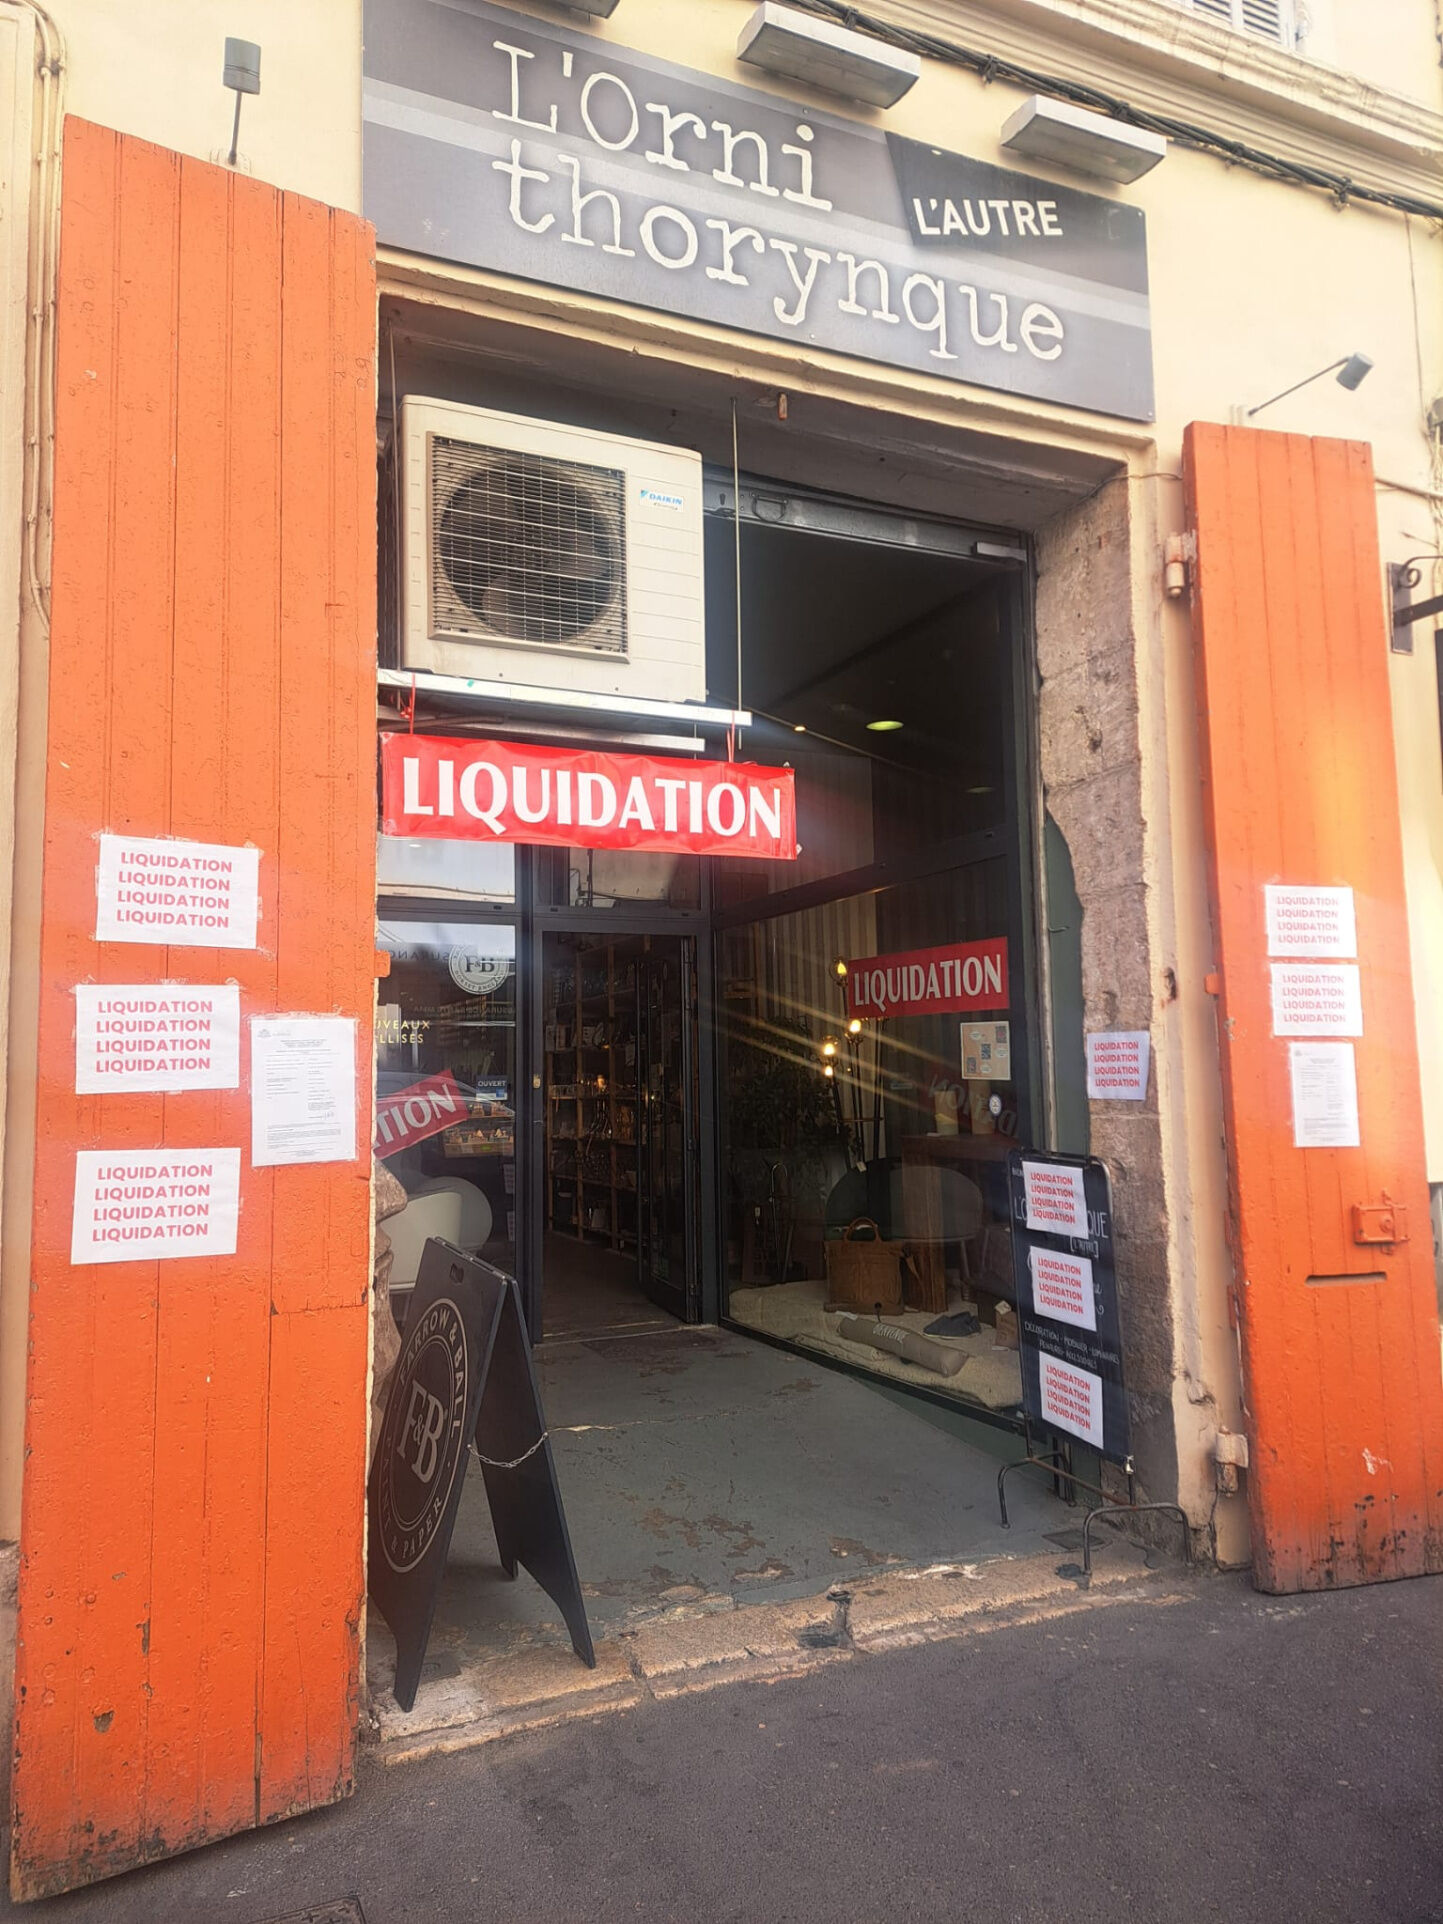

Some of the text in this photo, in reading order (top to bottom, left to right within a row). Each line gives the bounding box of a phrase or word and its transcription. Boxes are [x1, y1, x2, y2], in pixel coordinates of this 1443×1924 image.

[491, 40, 832, 211] L'Orni
[912, 198, 1064, 238] L'AUTRE
[491, 139, 1065, 362] thorynque
[649, 493, 683, 505] DAIKIN
[402, 756, 782, 839] LIQUIDATION
[121, 852, 232, 872] LIQUIDATION
[118, 872, 230, 891] LIQUIDATION
[118, 891, 229, 909] LIQUIDATION
[1277, 896, 1338, 906] LIQUIDATION
[117, 910, 229, 928] LIQUIDATION
[1277, 908, 1338, 919] LIQUIDATION
[1278, 921, 1338, 931] LIQUIDATION
[1278, 934, 1339, 944] LIQUIDATION
[853, 953, 1003, 1012] LIQUIDATION
[1283, 974, 1344, 985] LIQUIDATION
[1283, 986, 1344, 998] LIQUIDATION
[98, 1001, 212, 1015] LIQUIDATION
[1283, 1000, 1345, 1010] LIQUIDATION
[96, 1019, 210, 1033] LIQUIDATION
[1284, 1013, 1346, 1023] LIQUIDATION
[96, 1038, 210, 1055] LIQUIDATION
[1094, 1042, 1139, 1051] LIQUIDATION
[96, 1057, 210, 1073] LIQUIDATION
[1094, 1054, 1139, 1063] LIQUIDATION
[1094, 1066, 1139, 1075] LIQUIDATION
[1095, 1078, 1139, 1087] LIQUIDATION
[98, 1165, 212, 1181] LIQUIDATION
[1030, 1173, 1073, 1185] LIQUIDATION
[95, 1184, 210, 1201] LIQUIDATION
[1031, 1185, 1074, 1198] LIQUIDATION
[1031, 1197, 1074, 1210] LIQUIDATION
[94, 1204, 209, 1221] LIQUIDATION
[1033, 1209, 1075, 1224] LIQUIDATION
[92, 1224, 208, 1242] LIQUIDATION
[1038, 1259, 1080, 1275] LIQUIDATION
[1038, 1271, 1081, 1288] LIQUIDATION
[1039, 1284, 1082, 1301] LIQUIDATION
[1040, 1295, 1083, 1314] LIQUIDATION
[1047, 1366, 1090, 1391] LIQUIDATION
[450, 1345, 464, 1439] BALL
[1046, 1379, 1090, 1403] LIQUIDATION
[1047, 1390, 1090, 1416] LIQUIDATION
[1048, 1404, 1090, 1428] LIQUIDATION
[396, 1378, 445, 1484] F&B
